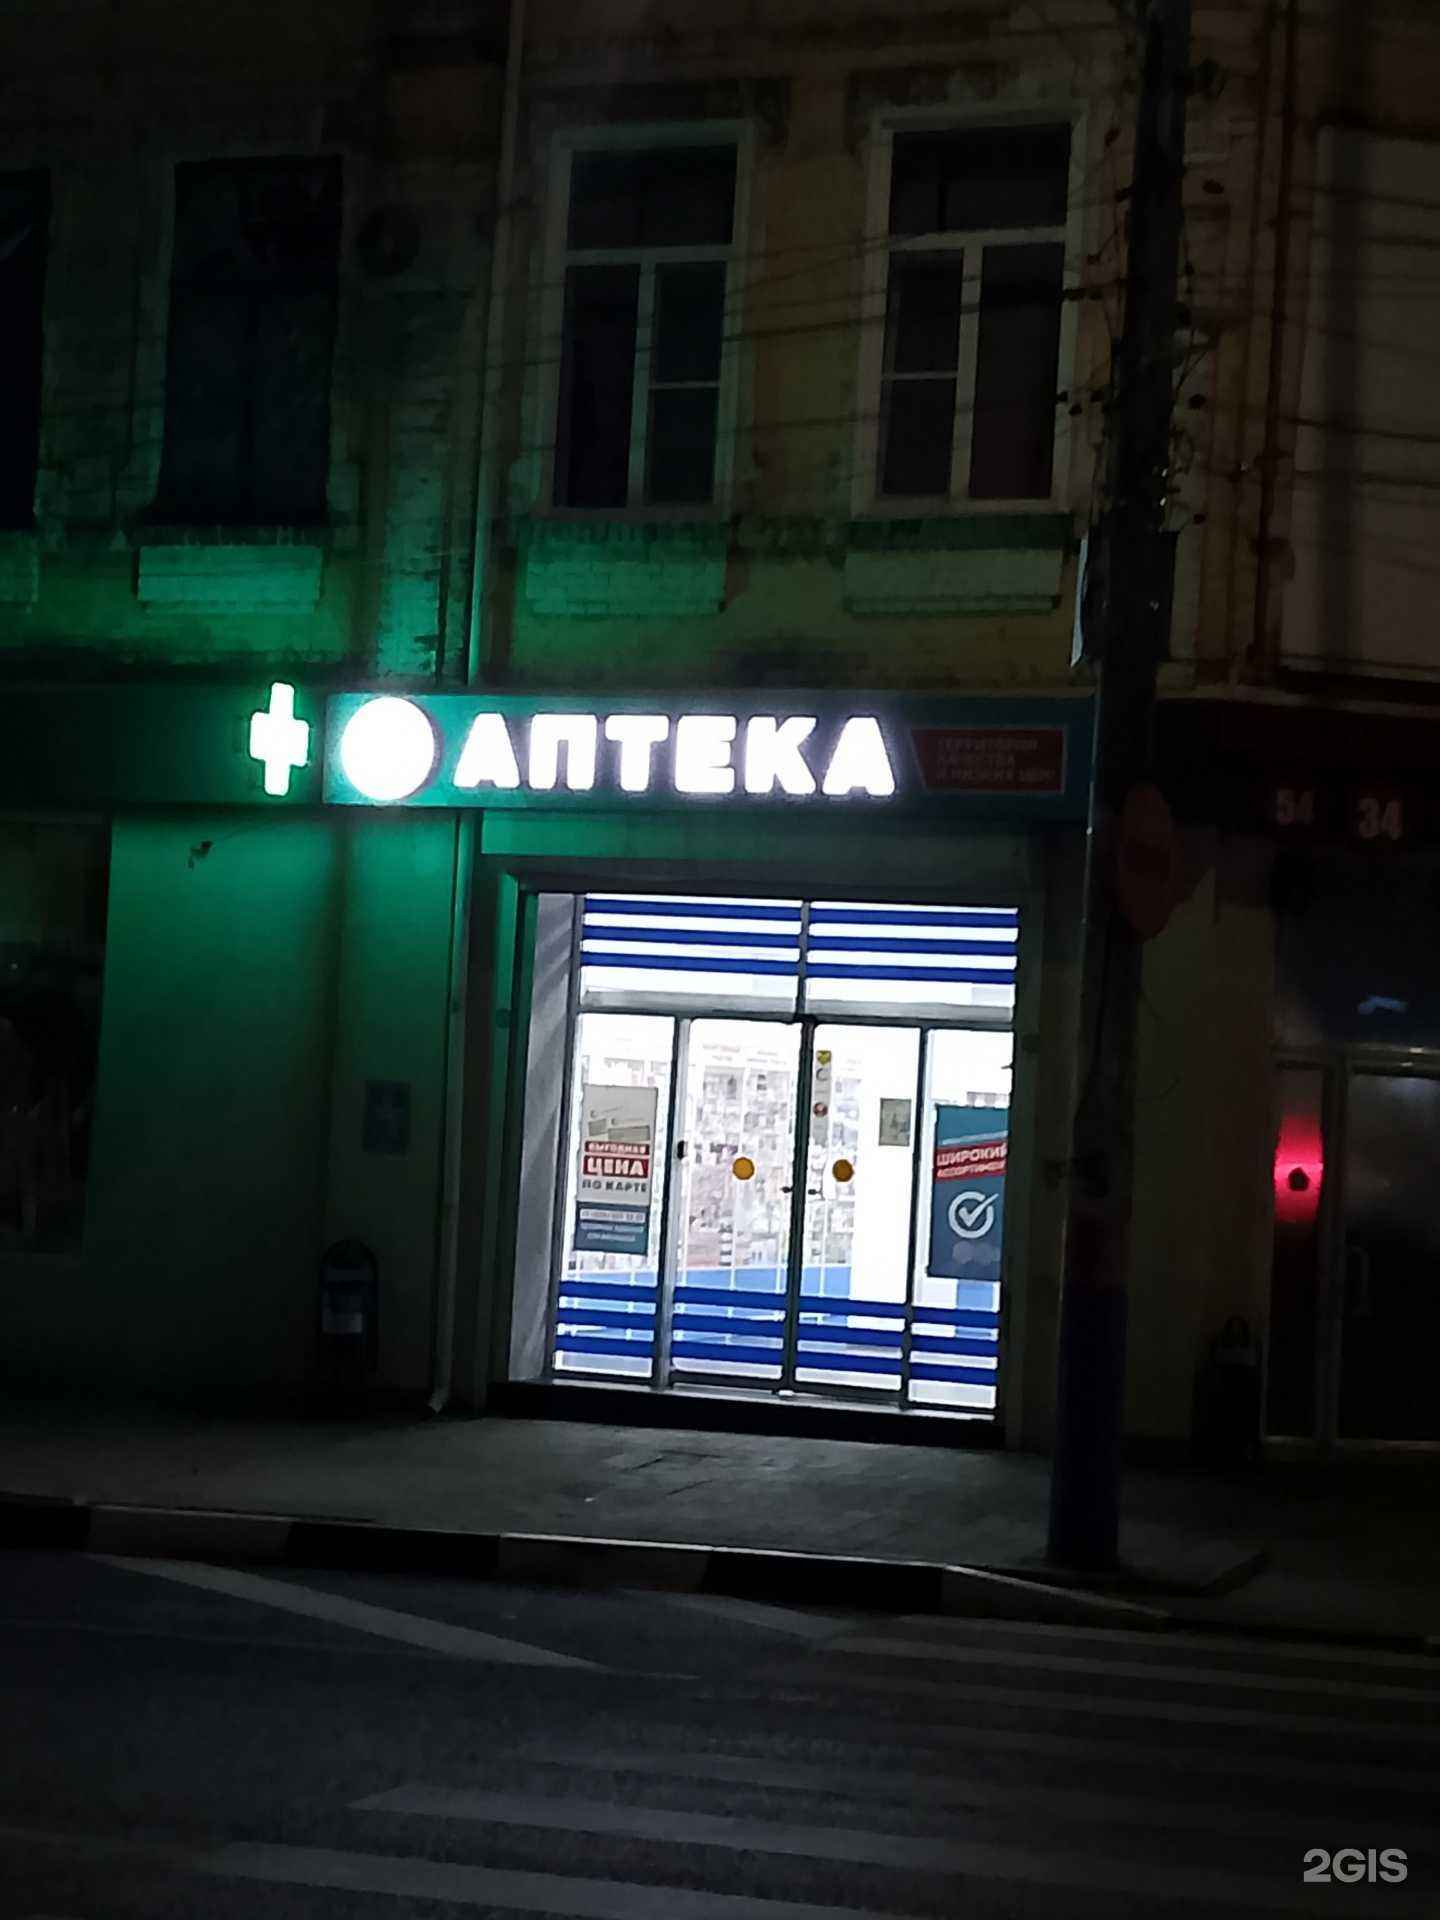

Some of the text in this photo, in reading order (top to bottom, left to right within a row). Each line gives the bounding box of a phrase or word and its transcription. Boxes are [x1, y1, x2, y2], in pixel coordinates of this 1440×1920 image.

[453, 712, 896, 796] АПТЕКА
[936, 1143, 1008, 1167] ШИРОКИЙ
[586, 1156, 645, 1177] ЦЕНА
[581, 1179, 648, 1193] ПО КАРТЕ
